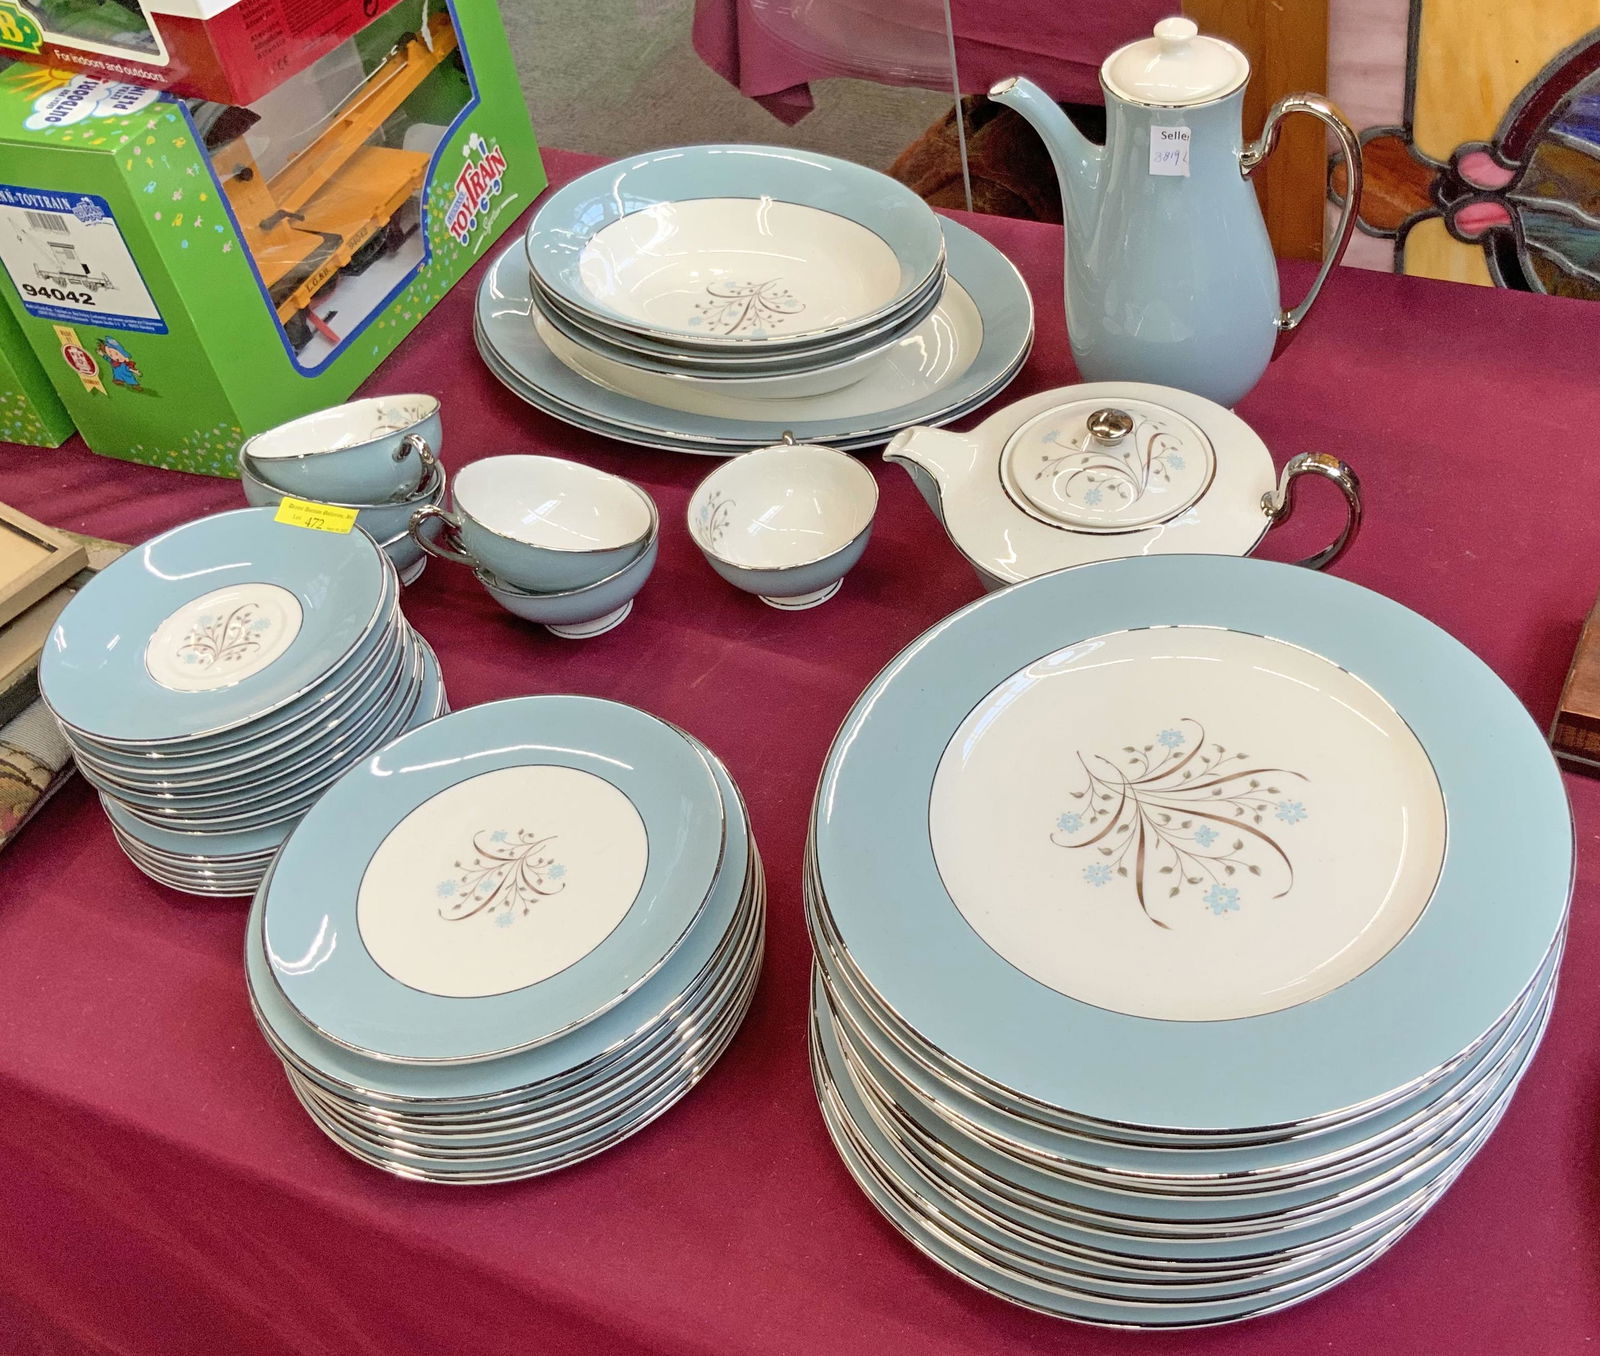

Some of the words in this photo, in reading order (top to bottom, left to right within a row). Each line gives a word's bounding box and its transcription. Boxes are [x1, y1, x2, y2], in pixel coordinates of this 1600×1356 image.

[54, 49, 71, 62] For
[70, 53, 105, 70] indoors
[105, 62, 124, 74] and
[22, 283, 96, 306] 94042
[304, 517, 325, 530] 472
